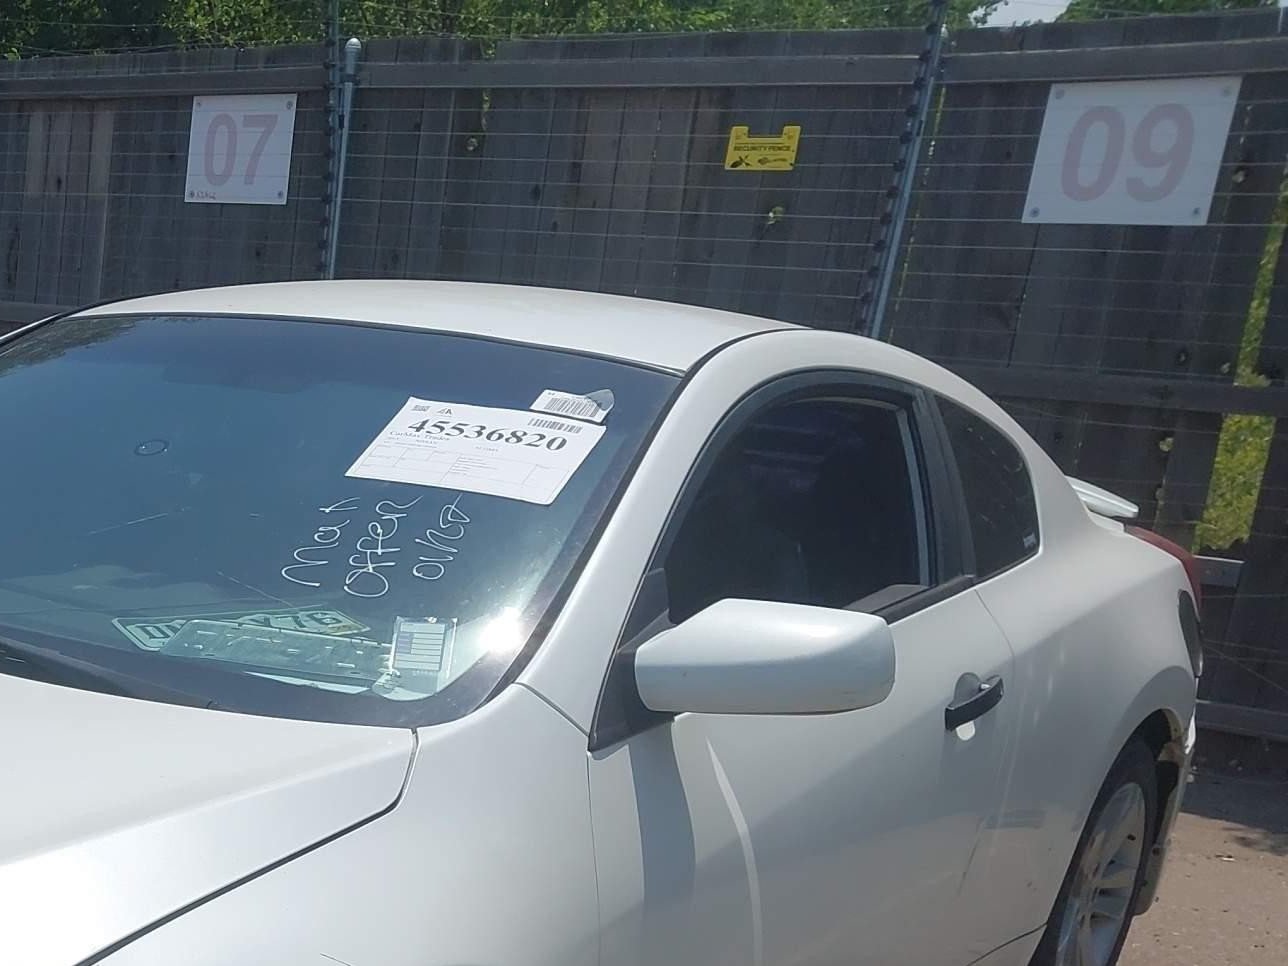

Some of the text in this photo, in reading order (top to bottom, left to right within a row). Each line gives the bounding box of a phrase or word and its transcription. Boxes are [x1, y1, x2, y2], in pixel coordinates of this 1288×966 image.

[204, 112, 279, 186] 07
[1061, 103, 1194, 202] 09
[407, 418, 569, 452] 45536820
